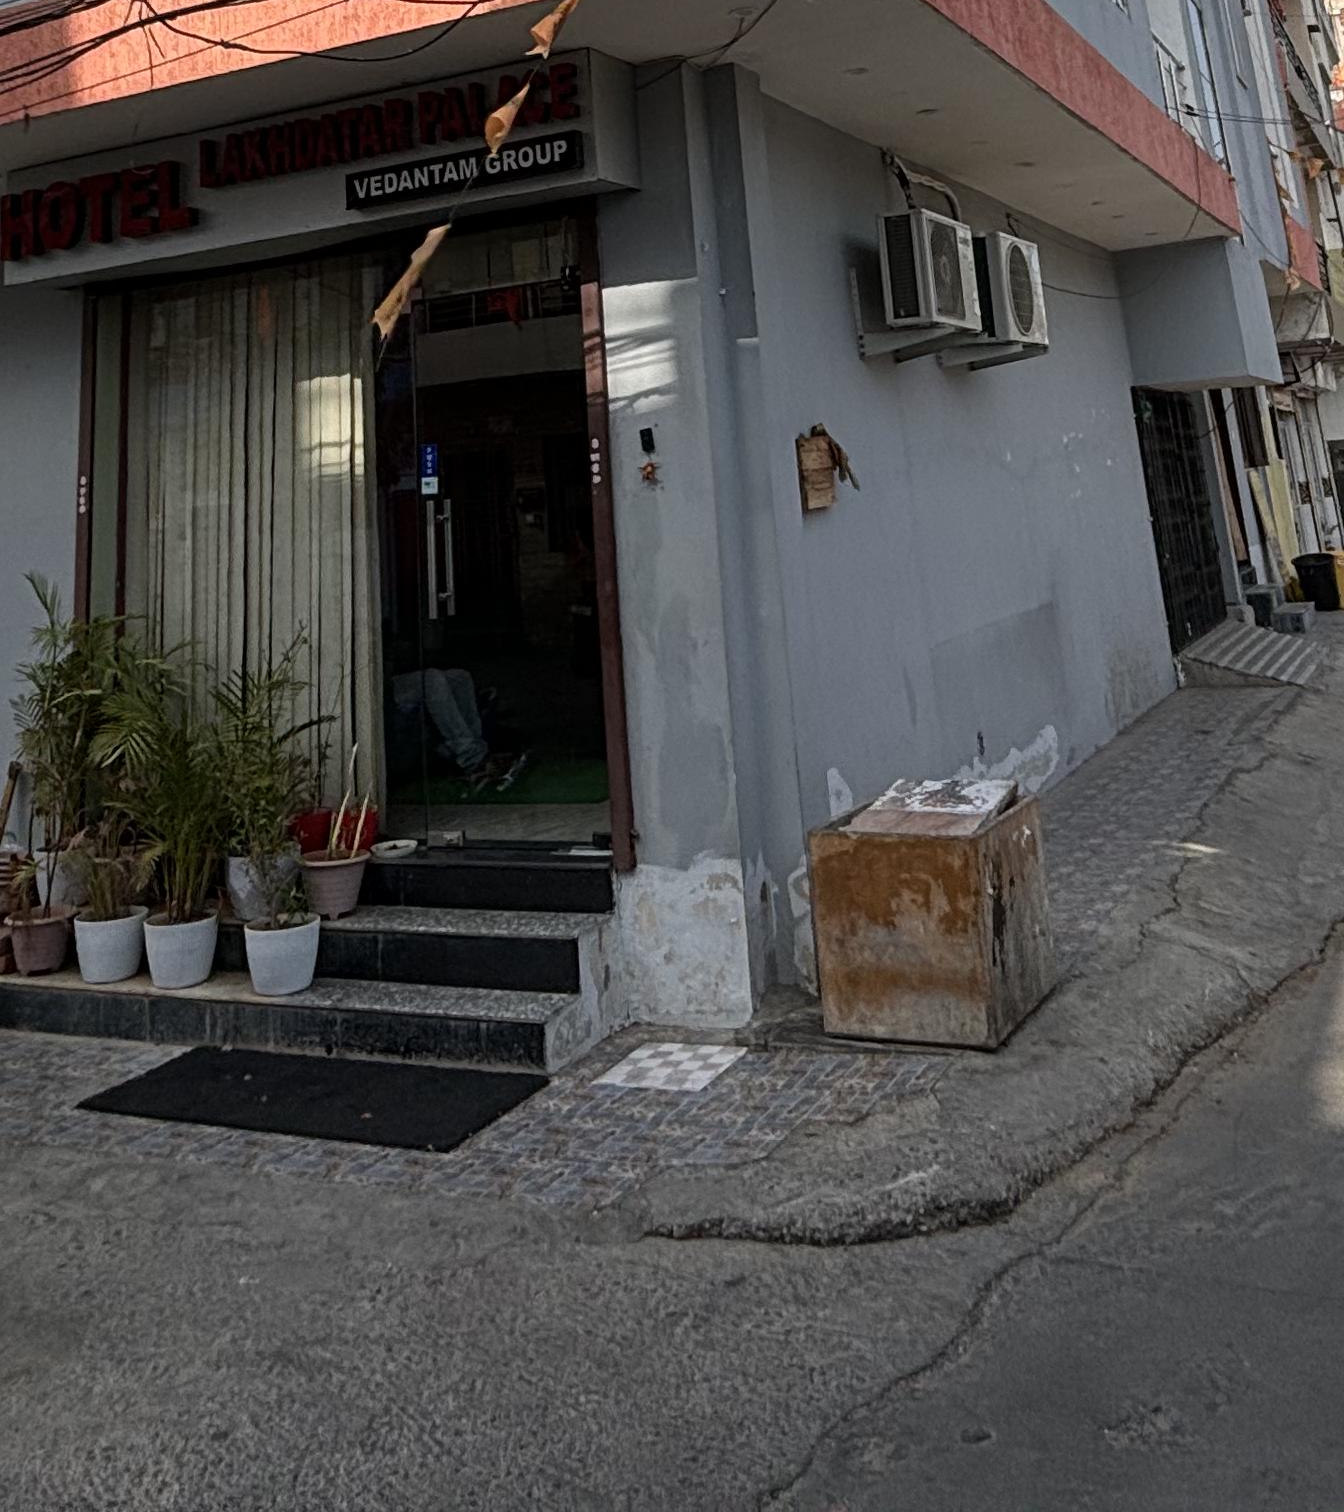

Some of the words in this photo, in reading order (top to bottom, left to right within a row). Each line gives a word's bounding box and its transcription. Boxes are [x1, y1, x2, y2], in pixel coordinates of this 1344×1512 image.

[0, 160, 200, 262] HOTEL
[199, 98, 415, 188] LAKHDATAR
[354, 156, 478, 200] VEDANTAM
[484, 139, 568, 175] GROUP
